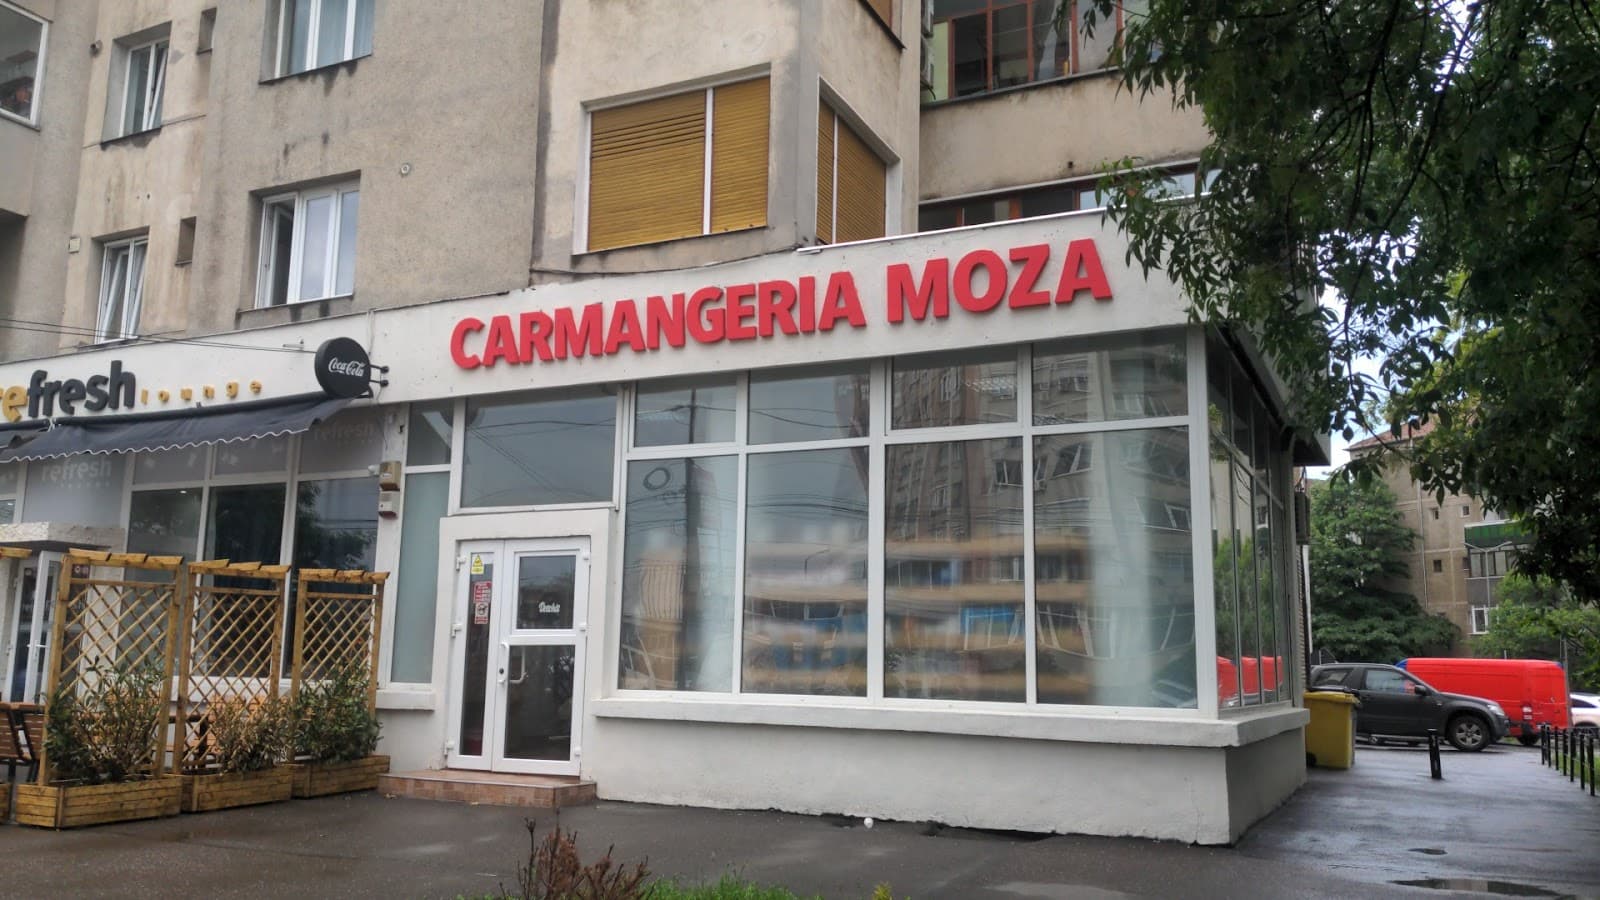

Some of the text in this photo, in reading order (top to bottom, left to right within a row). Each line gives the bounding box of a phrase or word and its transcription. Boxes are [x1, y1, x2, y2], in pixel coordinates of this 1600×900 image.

[450, 238, 1113, 369] CARMANGERIA MOZA
[0, 360, 263, 422] efresh lounge
